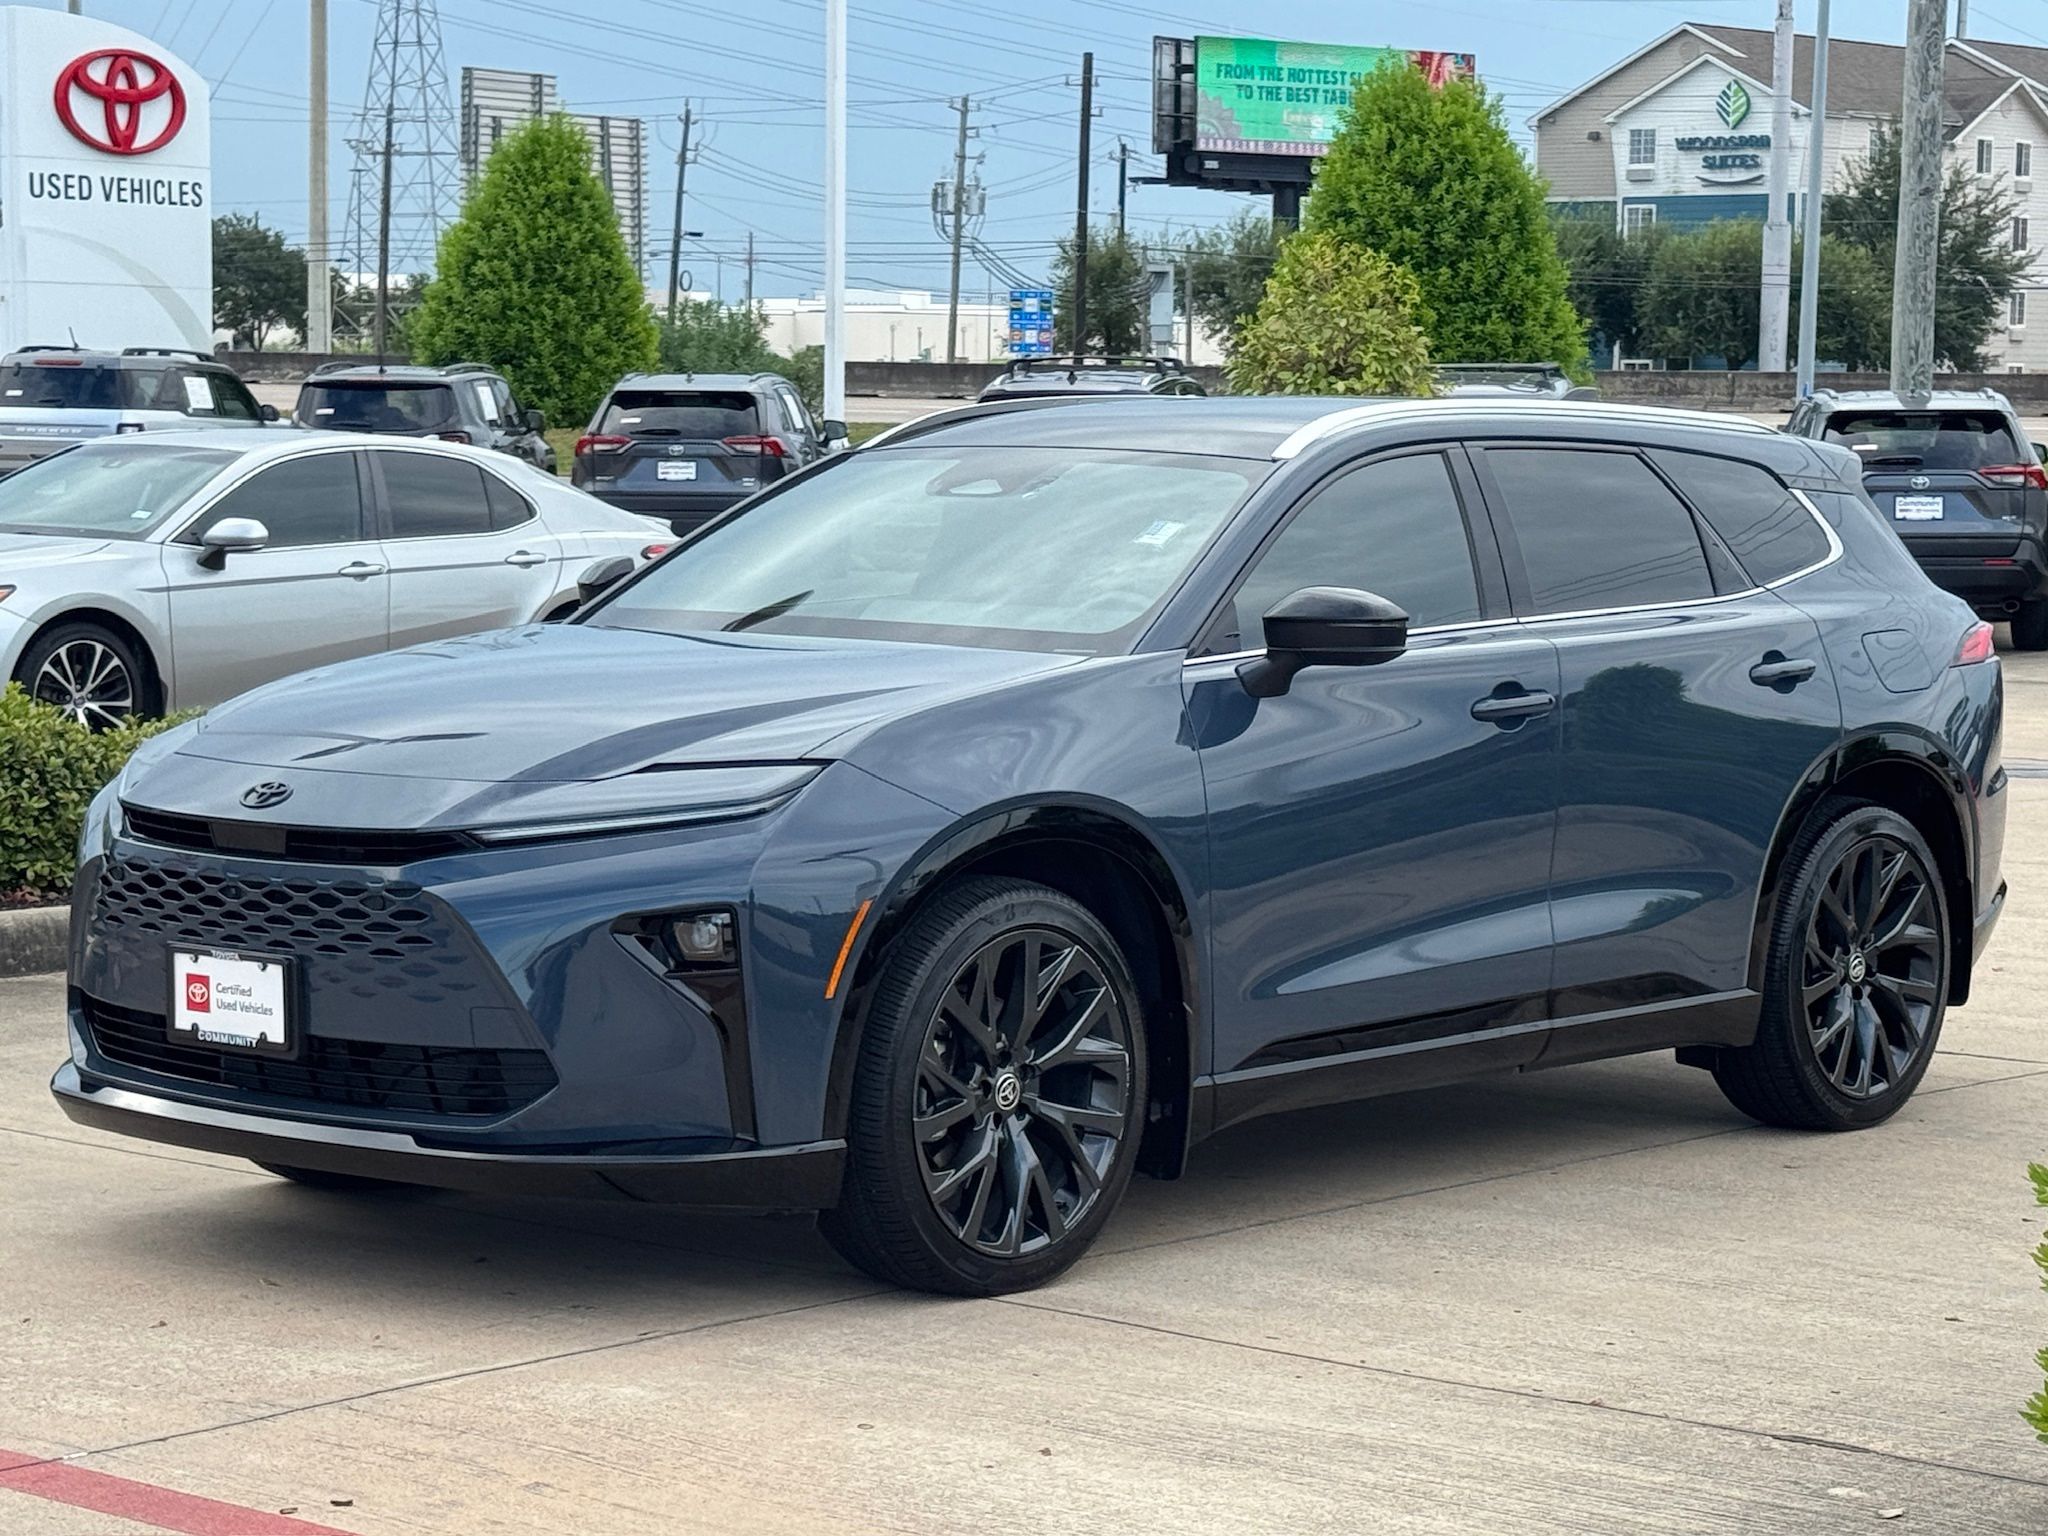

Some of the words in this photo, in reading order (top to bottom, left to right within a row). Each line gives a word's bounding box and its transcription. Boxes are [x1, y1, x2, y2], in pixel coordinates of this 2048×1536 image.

[1216, 63, 1254, 80] FROM
[1258, 66, 1284, 81] THE
[1287, 68, 1347, 85] HOTTEST
[1236, 84, 1253, 99] TO
[1257, 86, 1283, 101] THE
[1286, 88, 1319, 103] BEST
[29, 172, 92, 200] USED
[100, 176, 203, 207] VEHICLES
[215, 982, 252, 997] Certified
[216, 998, 237, 1012] Used
[239, 1001, 274, 1016] Vehicles
[198, 1030, 257, 1047] COMMUNITY
